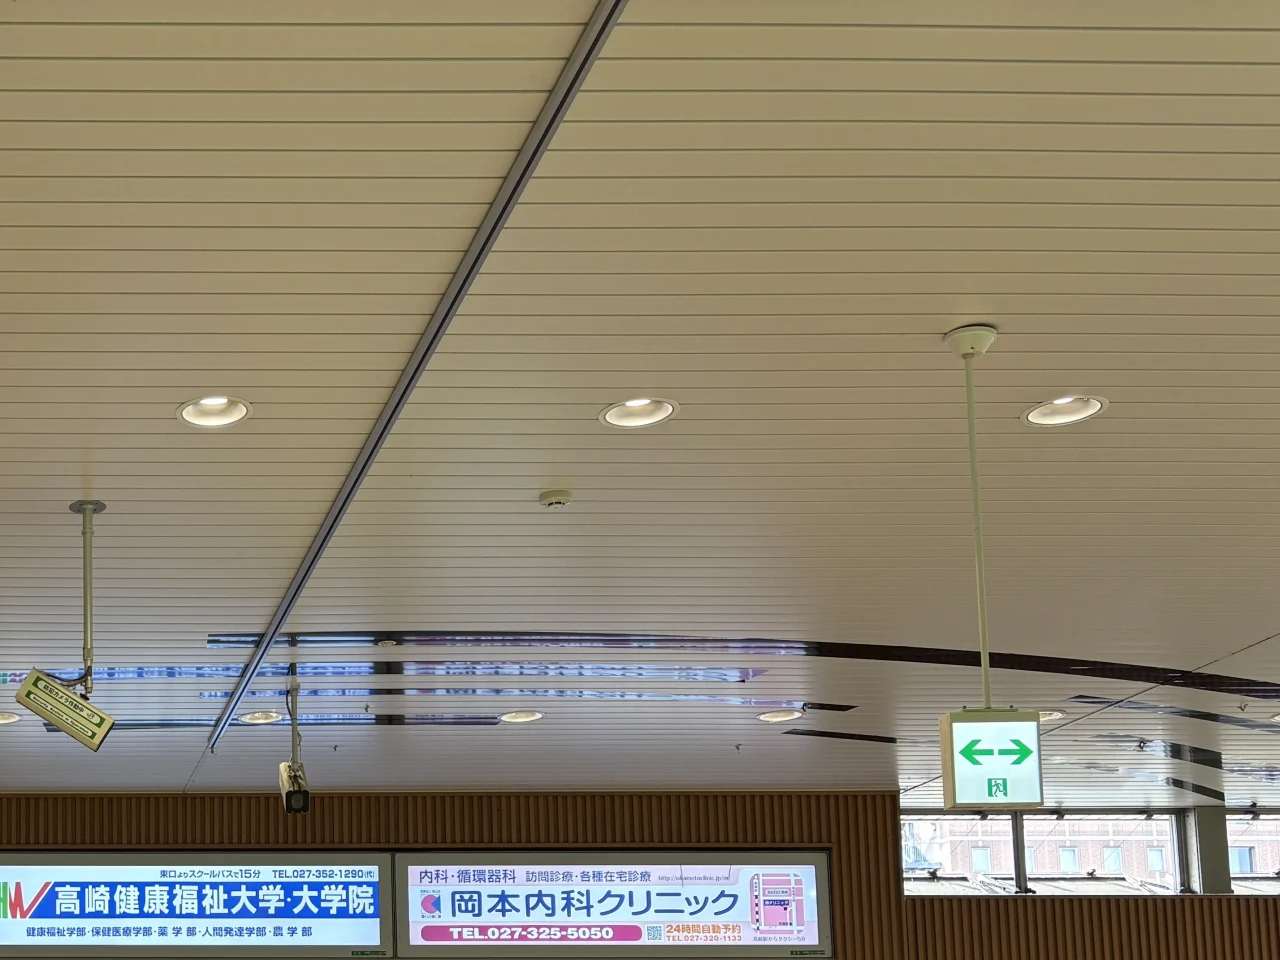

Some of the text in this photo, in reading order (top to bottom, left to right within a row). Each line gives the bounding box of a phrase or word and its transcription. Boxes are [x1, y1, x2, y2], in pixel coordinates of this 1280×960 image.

[160, 869, 261, 880] 東口よりスクールバスで15分
[420, 868, 652, 884] 内科・循環器科 訪問診療・各種在宅診療
[54, 884, 374, 915] 高崎健康福祉大学・大学院
[450, 889, 739, 918] 岡本内科クリニック
[449, 927, 614, 940] TEL.027-325-5050
[666, 924, 742, 934] 24時間自動予約
